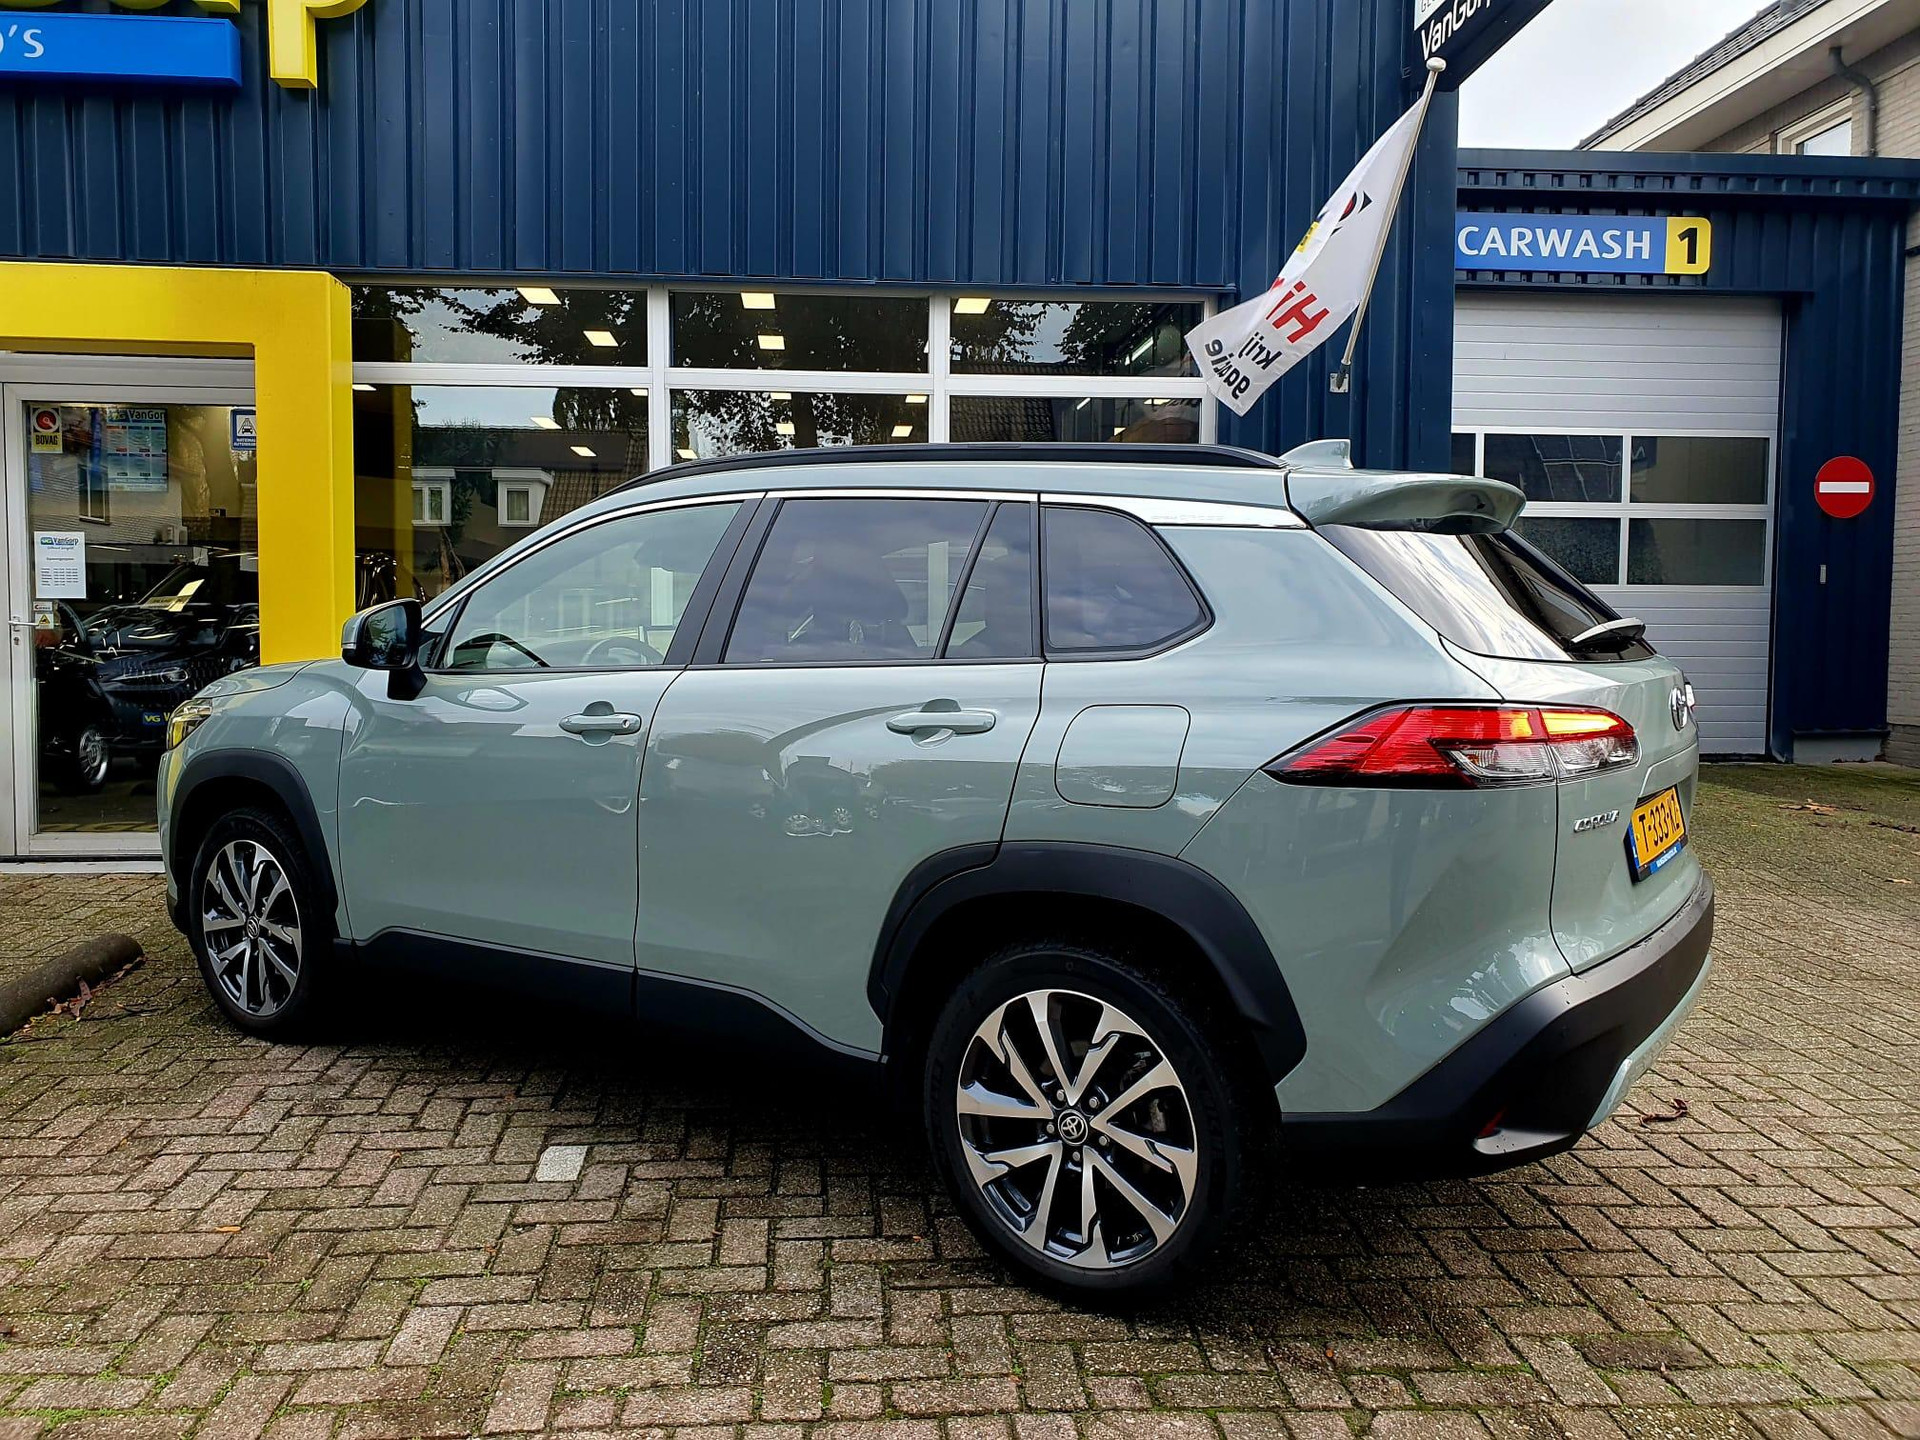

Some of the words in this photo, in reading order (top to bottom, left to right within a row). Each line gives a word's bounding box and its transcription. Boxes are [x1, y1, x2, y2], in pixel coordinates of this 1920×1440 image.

[0, 24, 45, 58] 'S
[1421, 0, 1490, 60] VanGo
[1457, 226, 1650, 260] CARWASH
[1677, 227, 1698, 265] 1
[35, 434, 58, 446] BOVAG
[53, 537, 79, 546] VanGorp
[144, 715, 161, 723] VG
